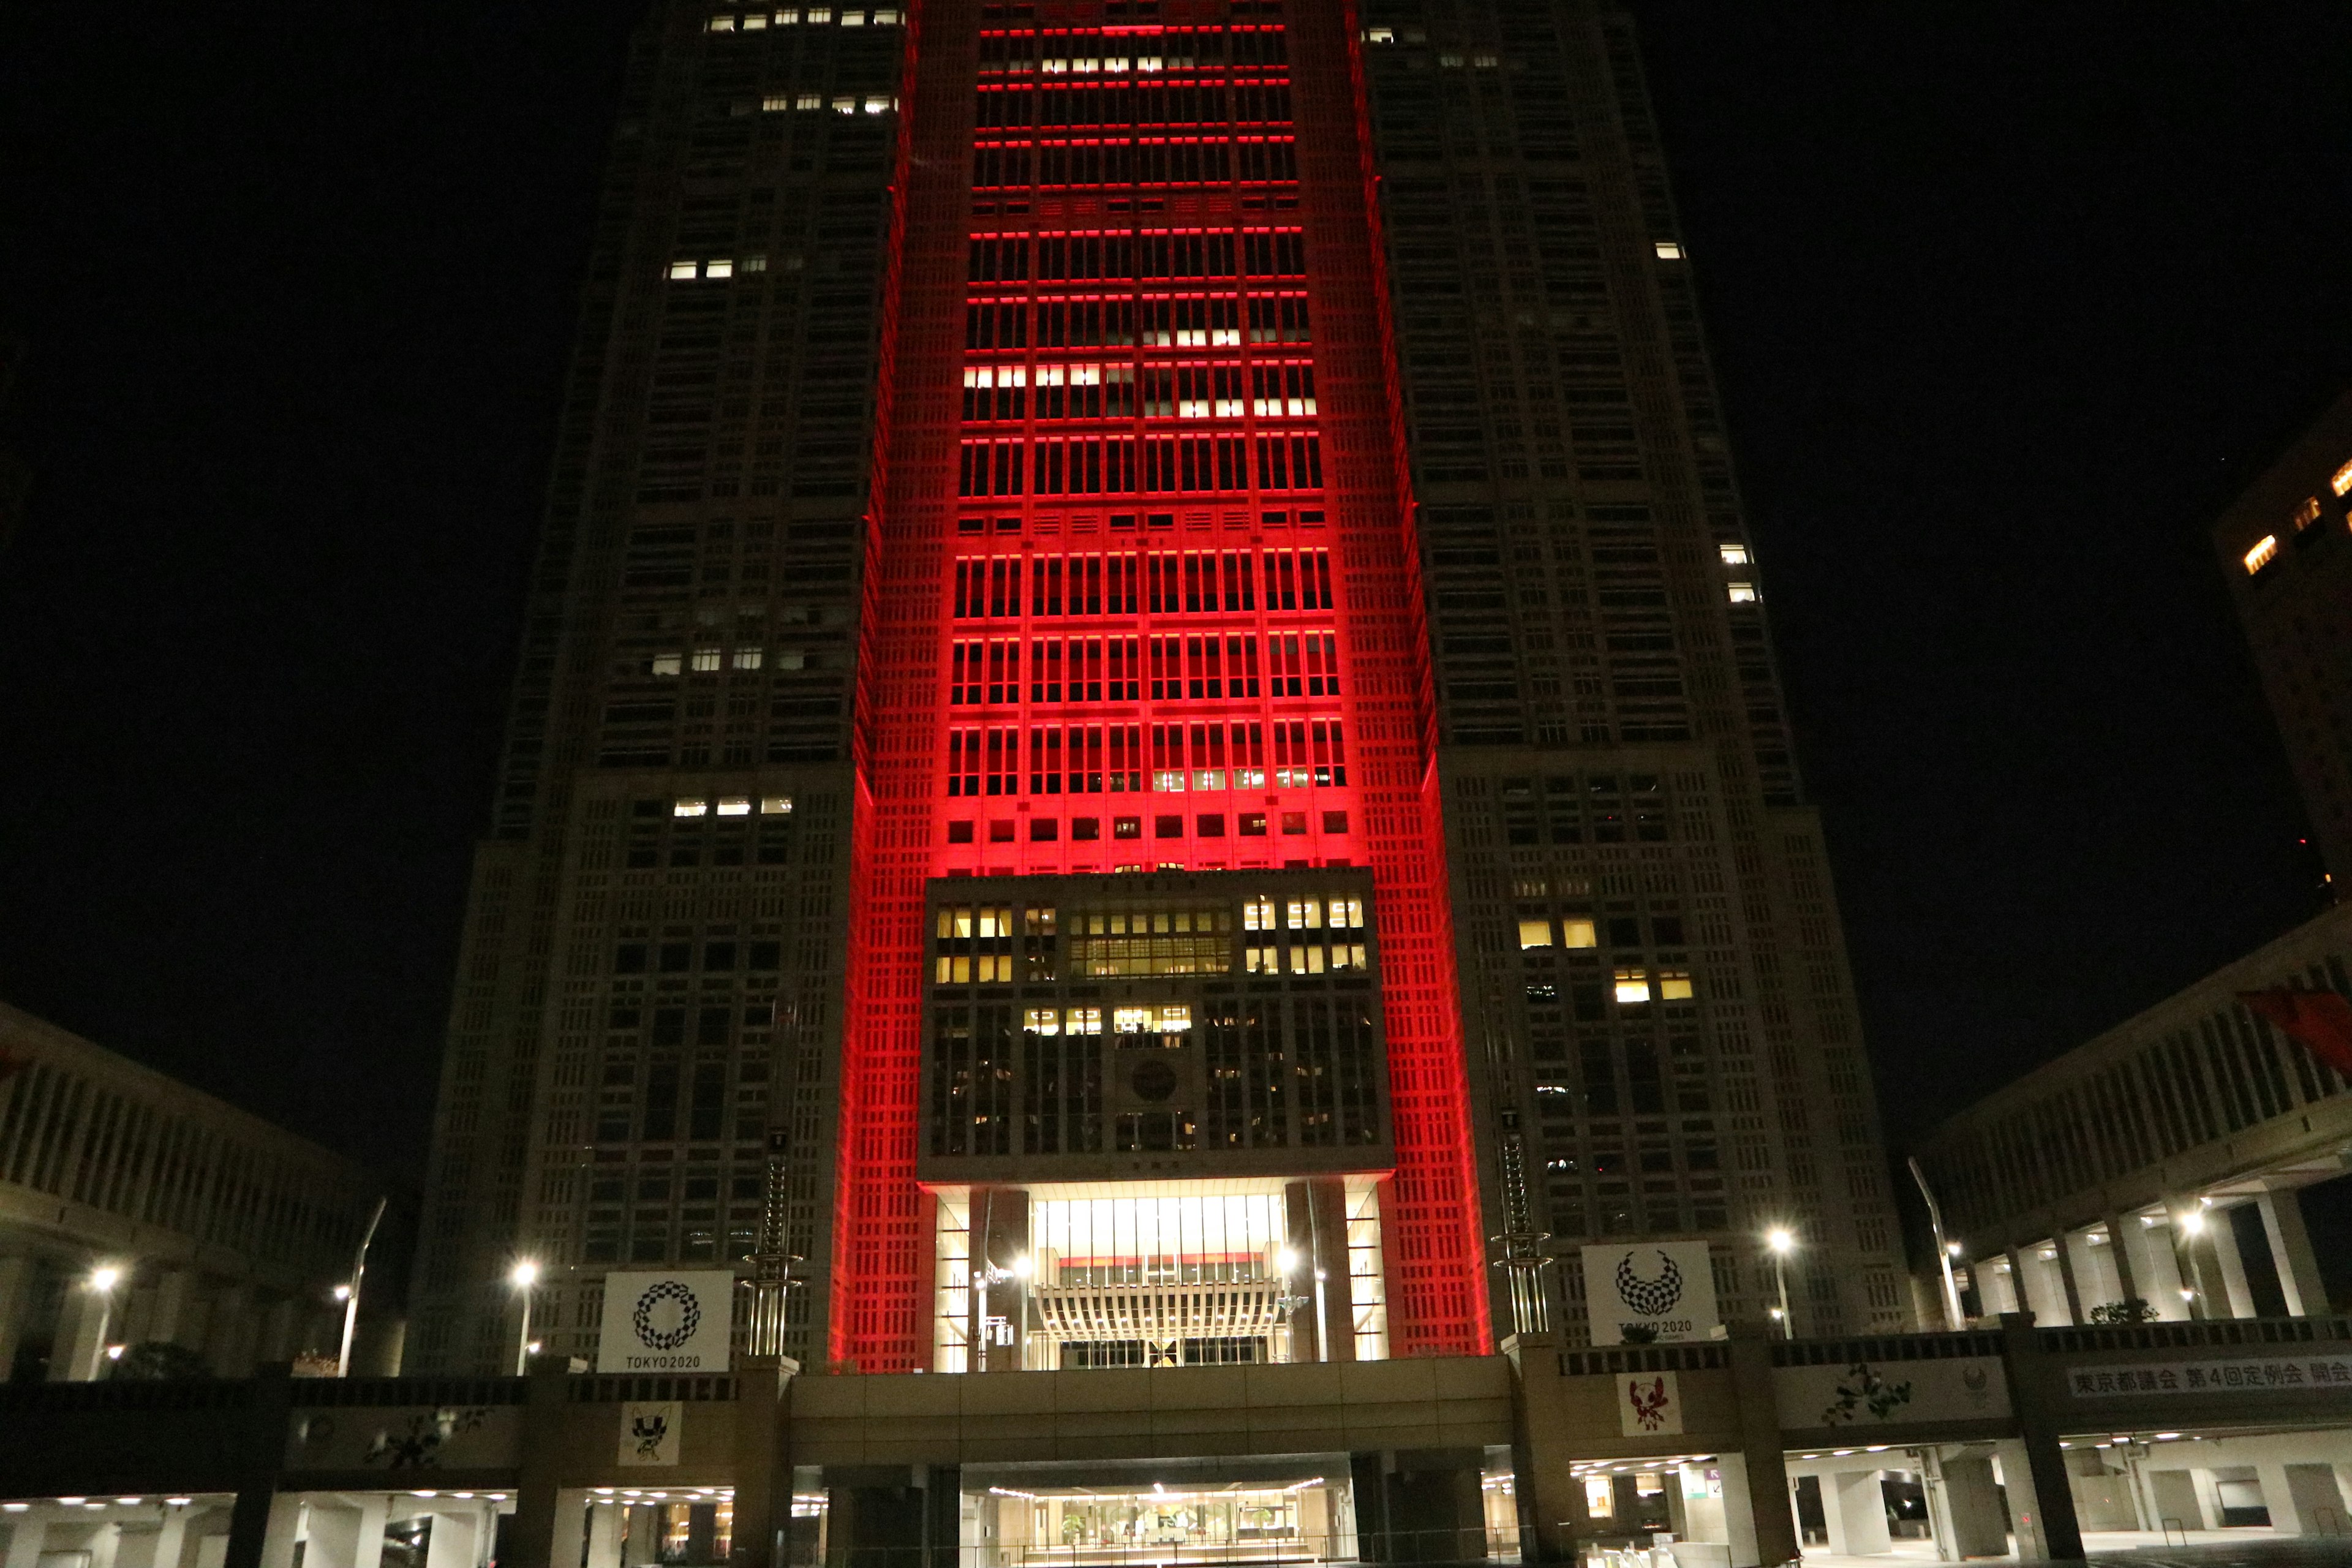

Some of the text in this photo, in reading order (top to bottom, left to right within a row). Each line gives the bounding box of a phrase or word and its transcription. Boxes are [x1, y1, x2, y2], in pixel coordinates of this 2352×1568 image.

[1662, 1320, 1691, 1332] 2020
[627, 1356, 700, 1368] TOKYO 2020
[2075, 1369, 2179, 1393] 東京都議会
[2186, 1363, 2303, 1387] 第4回定例会
